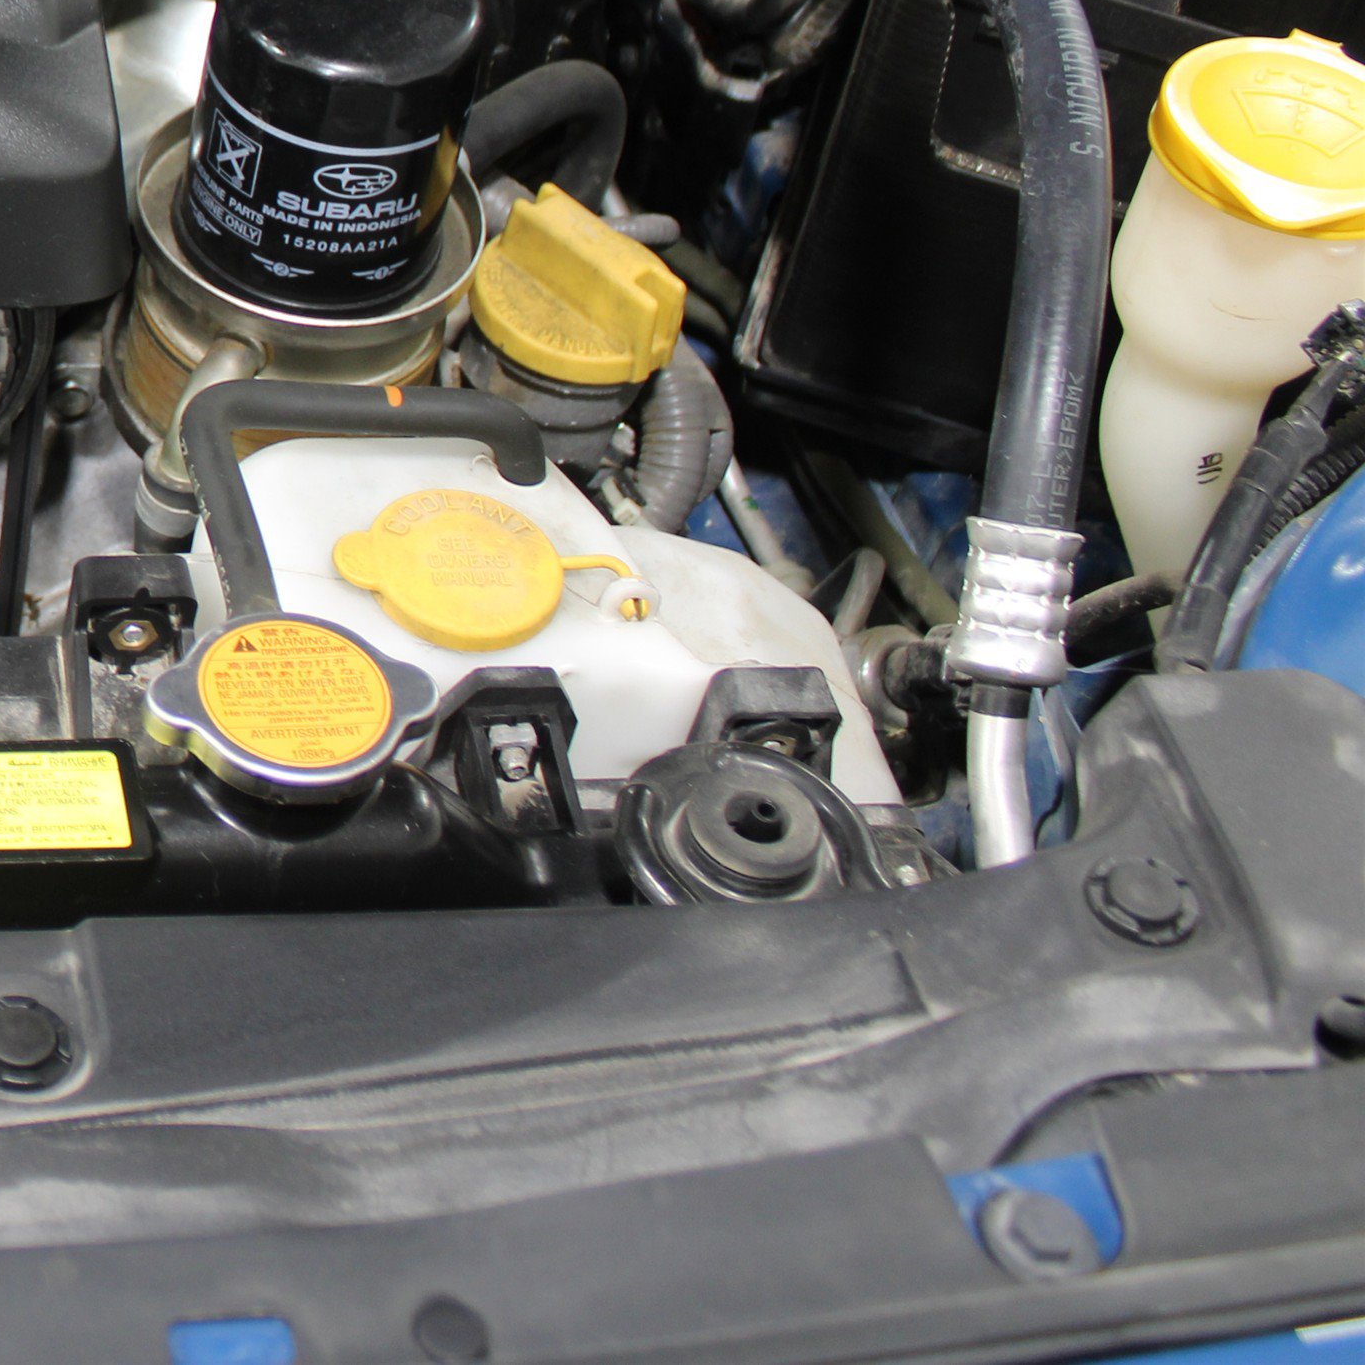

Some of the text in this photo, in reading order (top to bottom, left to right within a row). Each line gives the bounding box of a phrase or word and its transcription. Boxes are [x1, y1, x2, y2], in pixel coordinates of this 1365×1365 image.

[229, 196, 264, 225] PARTS
[277, 190, 417, 219] SUBARU
[262, 204, 422, 233] MADE IN INDONESIA
[226, 215, 258, 240] ONLY
[282, 233, 399, 255] 15208AA21A
[383, 493, 538, 536] COOLANT
[436, 537, 477, 551] SEE
[431, 571, 513, 586] MANUAL
[258, 636, 330, 647] WARNING
[261, 646, 349, 656] ПРЕДУПРЕЖДЕНИЕ
[216, 680, 256, 689] NEVER
[262, 679, 294, 689] OPEN
[301, 677, 336, 687] WHEN
[219, 689, 233, 699] NE
[237, 688, 274, 699] JAMAIS
[279, 688, 318, 698] OUVRIR
[251, 726, 362, 740] AVERTISSEMENT
